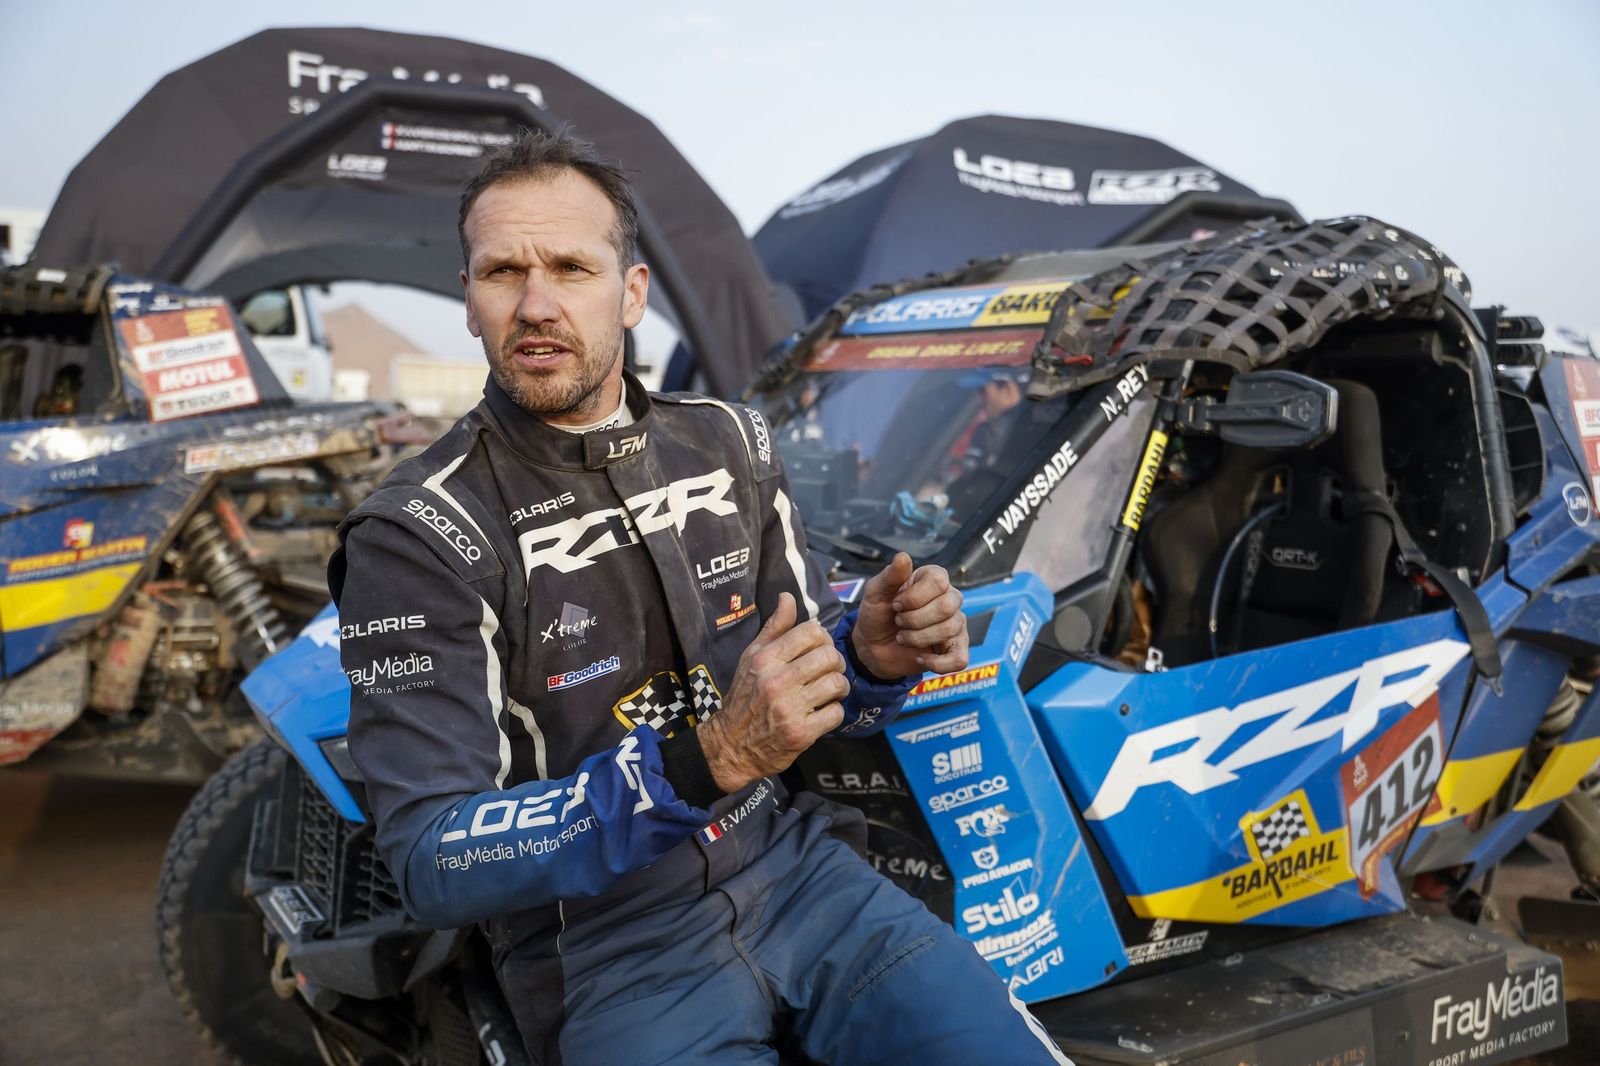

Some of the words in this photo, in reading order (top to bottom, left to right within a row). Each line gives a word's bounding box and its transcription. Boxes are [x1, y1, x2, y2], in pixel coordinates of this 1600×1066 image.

[953, 147, 1076, 191] LOEB
[159, 361, 235, 392] MOTUL
[1100, 396, 1122, 422] N.
[1116, 363, 1149, 403] REY
[607, 431, 647, 459] LFM
[744, 408, 772, 465] sparco
[983, 527, 1004, 555] F.
[997, 441, 1079, 535] VAYSSADE
[1129, 441, 1168, 528] BARDAHL
[509, 491, 576, 526] OLARIS
[401, 499, 482, 566] sparco
[696, 547, 750, 579] LOEB
[341, 614, 427, 640] OLARIS
[345, 652, 434, 686] rayMédia
[548, 656, 620, 688] BFGoodrich
[923, 663, 1000, 693] MARTIN
[363, 686, 393, 697] MEDIA
[396, 679, 436, 693] FACTORY
[916, 677, 999, 706] ENTREPRENEUR
[934, 765, 983, 784] SOCOTRAS
[1357, 735, 1436, 850] 412
[928, 775, 1009, 814] sparco
[955, 803, 1009, 837] FOX
[435, 843, 514, 871] FrayMédia
[517, 814, 601, 857] Motorsport
[988, 858, 1034, 881] ARMOR
[1231, 840, 1339, 899] BARDAHL
[962, 886, 1040, 934] Stilo
[1430, 965, 1559, 1044] FrayMédia
[1469, 1036, 1505, 1060] MEDIA
[1508, 1019, 1556, 1045] FACTORY
